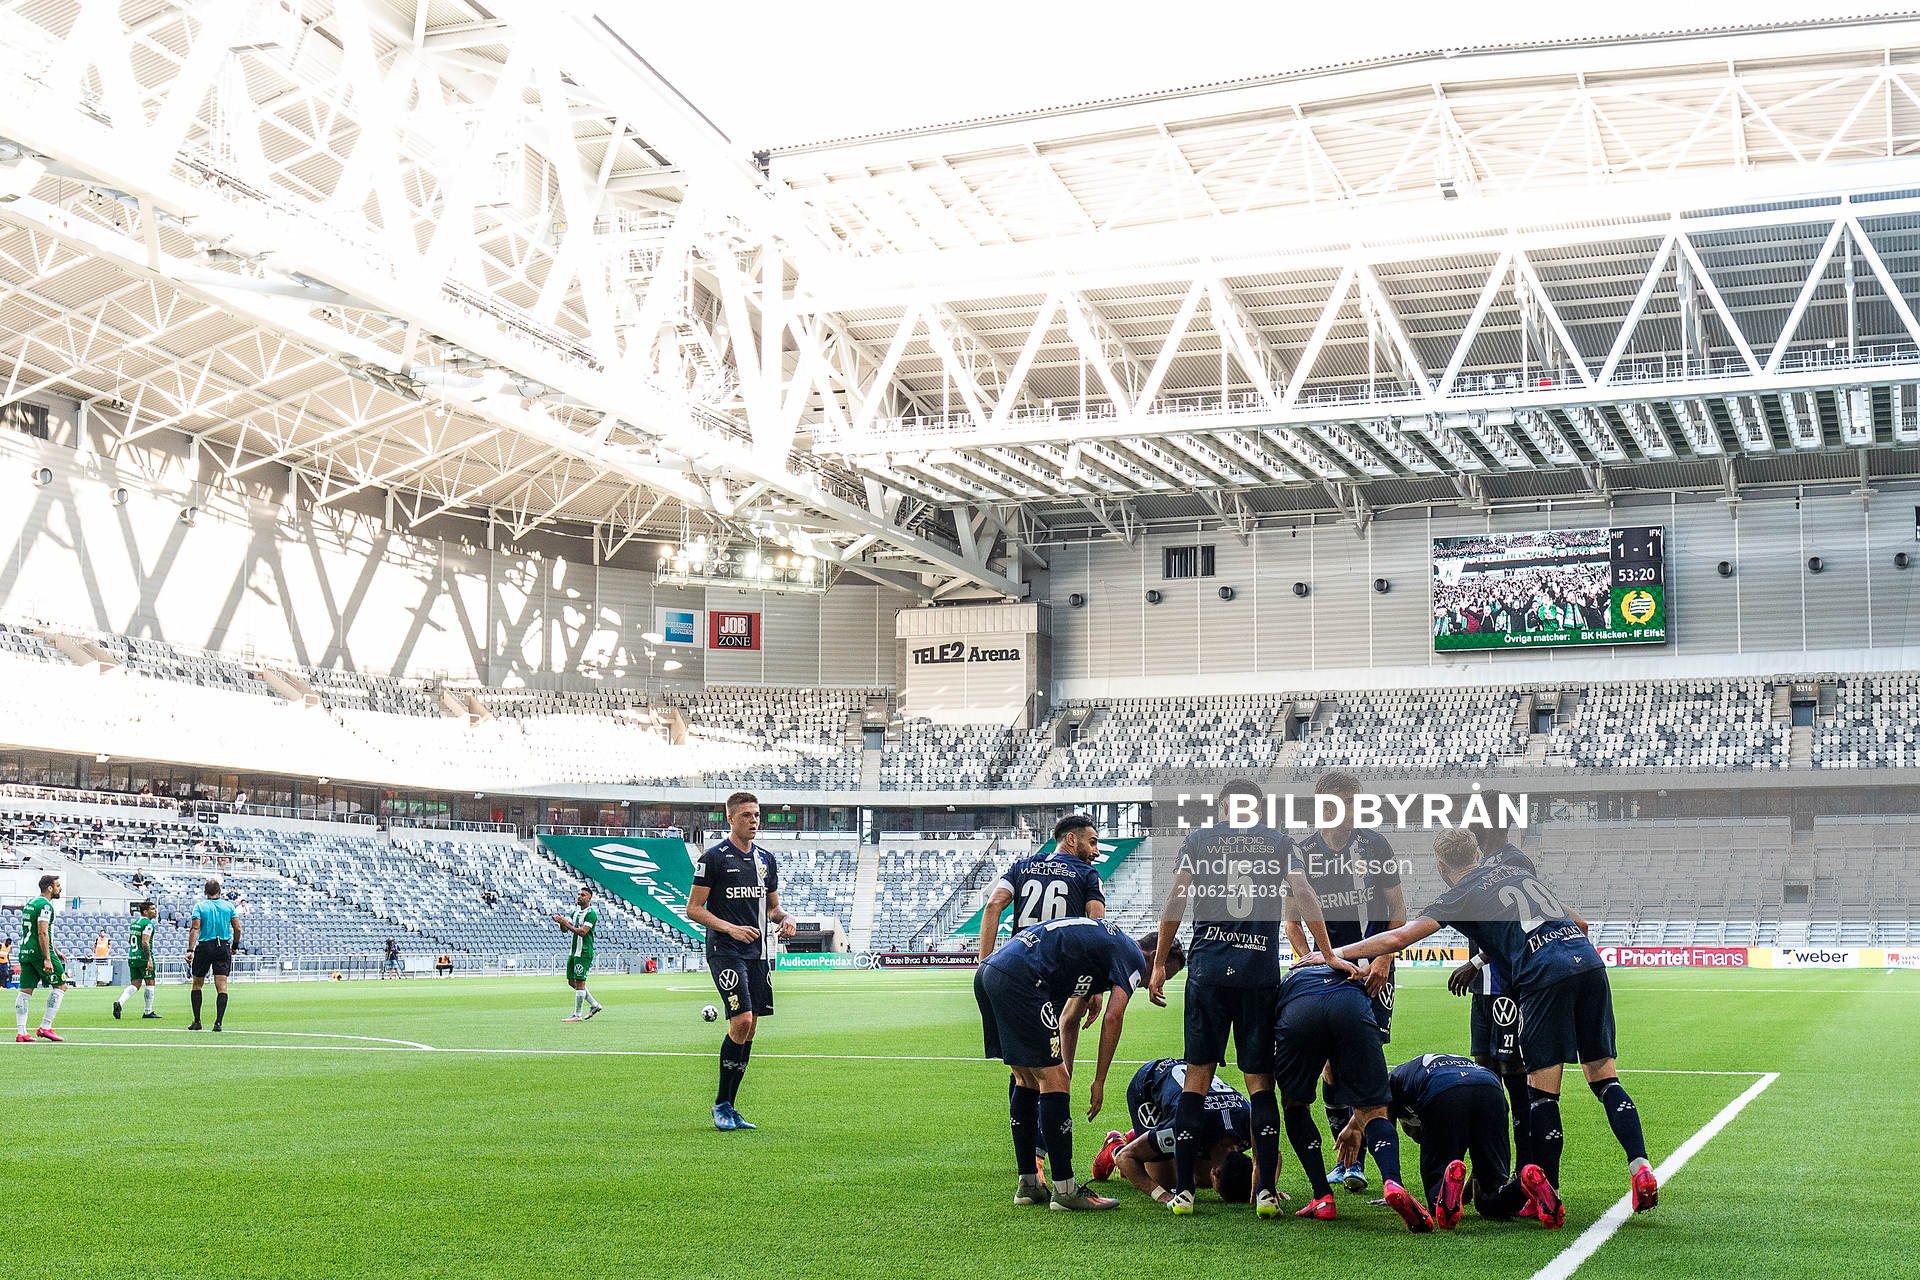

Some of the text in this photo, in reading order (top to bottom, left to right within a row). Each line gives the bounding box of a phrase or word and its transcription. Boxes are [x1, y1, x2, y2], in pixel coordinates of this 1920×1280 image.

[1611, 529, 1661, 539] HIF IFK
[1618, 543, 1625, 558] 1
[1646, 542, 1653, 557] 1
[1618, 568, 1655, 581] 53:20
[720, 616, 746, 635] JOB
[1504, 633, 1571, 644] Övriga matcher:
[1581, 631, 1594, 640] BK
[1596, 630, 1628, 640] Häcken
[1634, 629, 1642, 638] IF
[718, 635, 751, 647] ZONE
[912, 641, 1021, 664] TELE2 Arena
[1218, 836, 1265, 845] NORDIC
[1206, 845, 1275, 854] WELLNESS
[1031, 861, 1068, 870] NORDIC
[1020, 867, 1077, 879] WELLNESS
[1226, 861, 1254, 919] 6
[1017, 879, 1069, 928] 26
[779, 956, 852, 967] AudicomPendax
[1620, 949, 1690, 966] Prioritet
[1693, 949, 1744, 966] Finans
[1796, 949, 1849, 963] weber
[1504, 1034, 1513, 1047] 27
